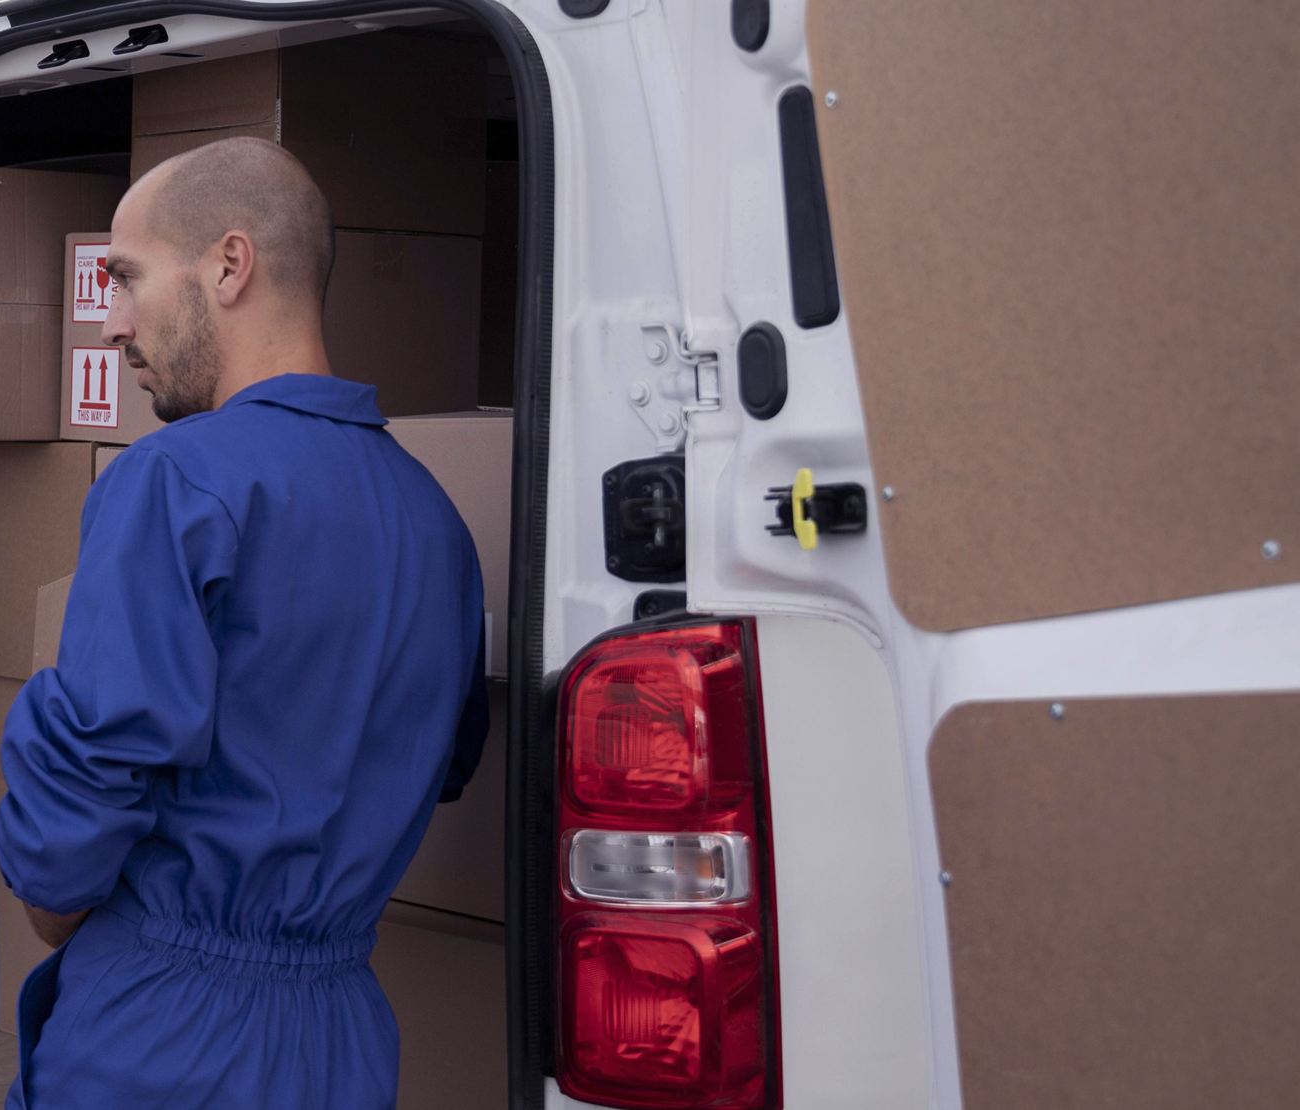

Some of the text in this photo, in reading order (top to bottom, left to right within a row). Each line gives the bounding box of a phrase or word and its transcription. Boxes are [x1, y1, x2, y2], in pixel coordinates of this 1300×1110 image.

[78, 410, 111, 423] THIS WAY UP
